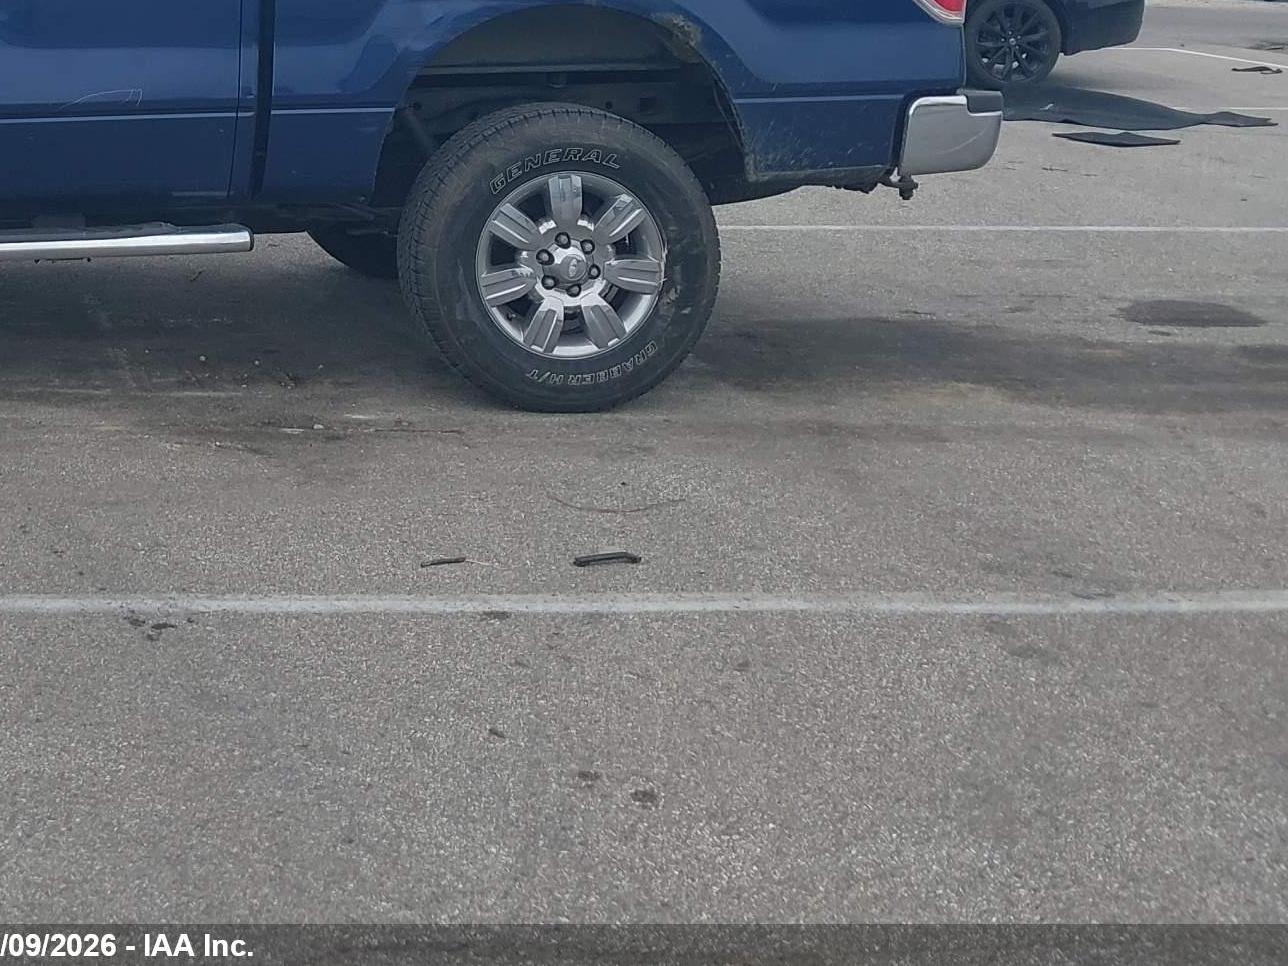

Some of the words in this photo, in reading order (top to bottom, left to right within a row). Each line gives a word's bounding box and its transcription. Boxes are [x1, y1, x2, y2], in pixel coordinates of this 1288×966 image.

[489, 147, 621, 194] GENERAL
[525, 369, 564, 385] H/T
[567, 340, 658, 386] GRABBER
